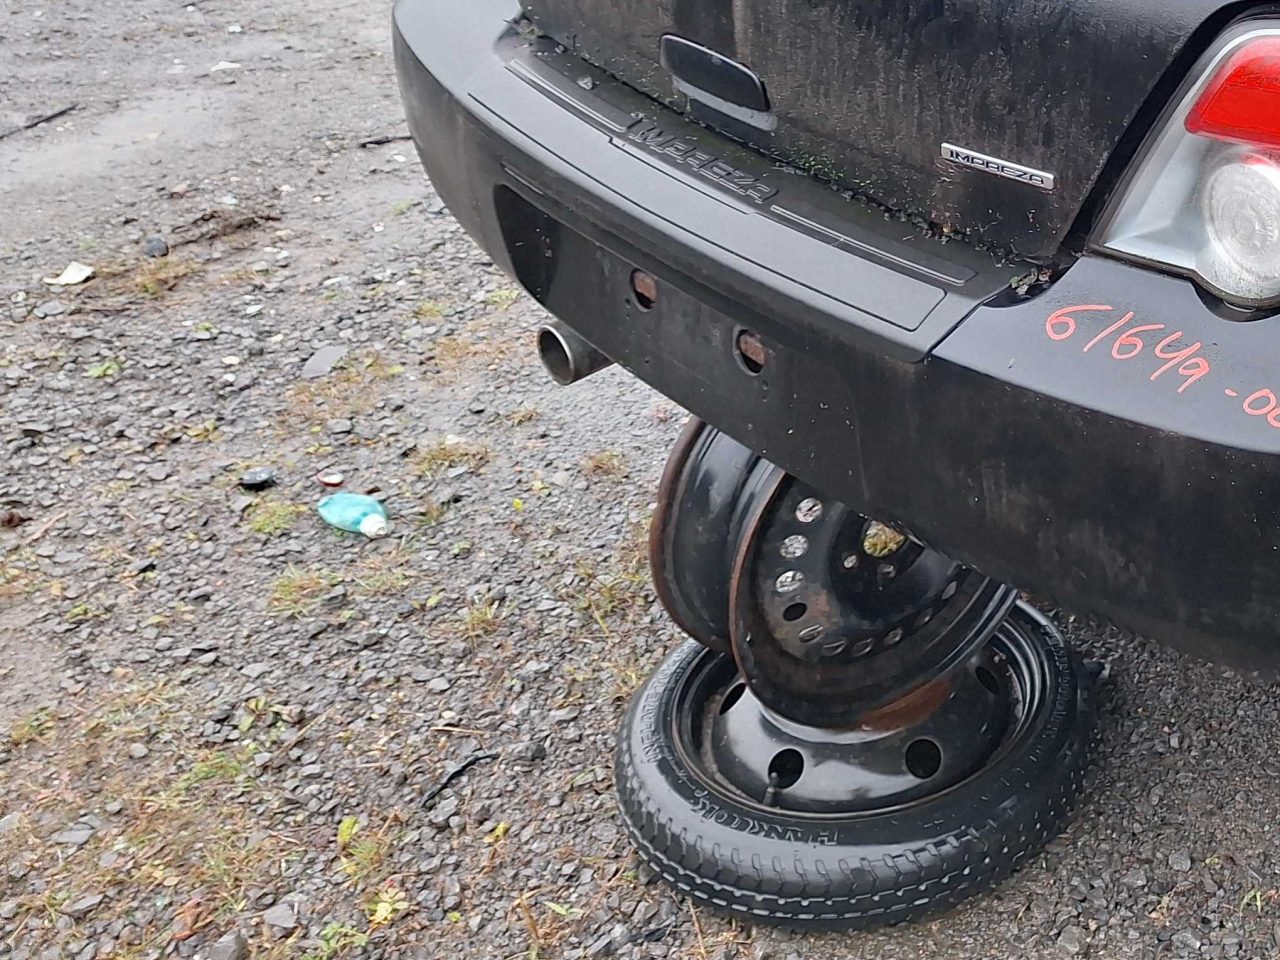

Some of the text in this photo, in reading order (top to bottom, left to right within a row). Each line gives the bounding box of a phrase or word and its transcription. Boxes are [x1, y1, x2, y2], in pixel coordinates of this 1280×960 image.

[627, 117, 780, 204] IMPREZA
[948, 148, 1046, 186] IMPREZA
[690, 798, 839, 847] HANKOOK
